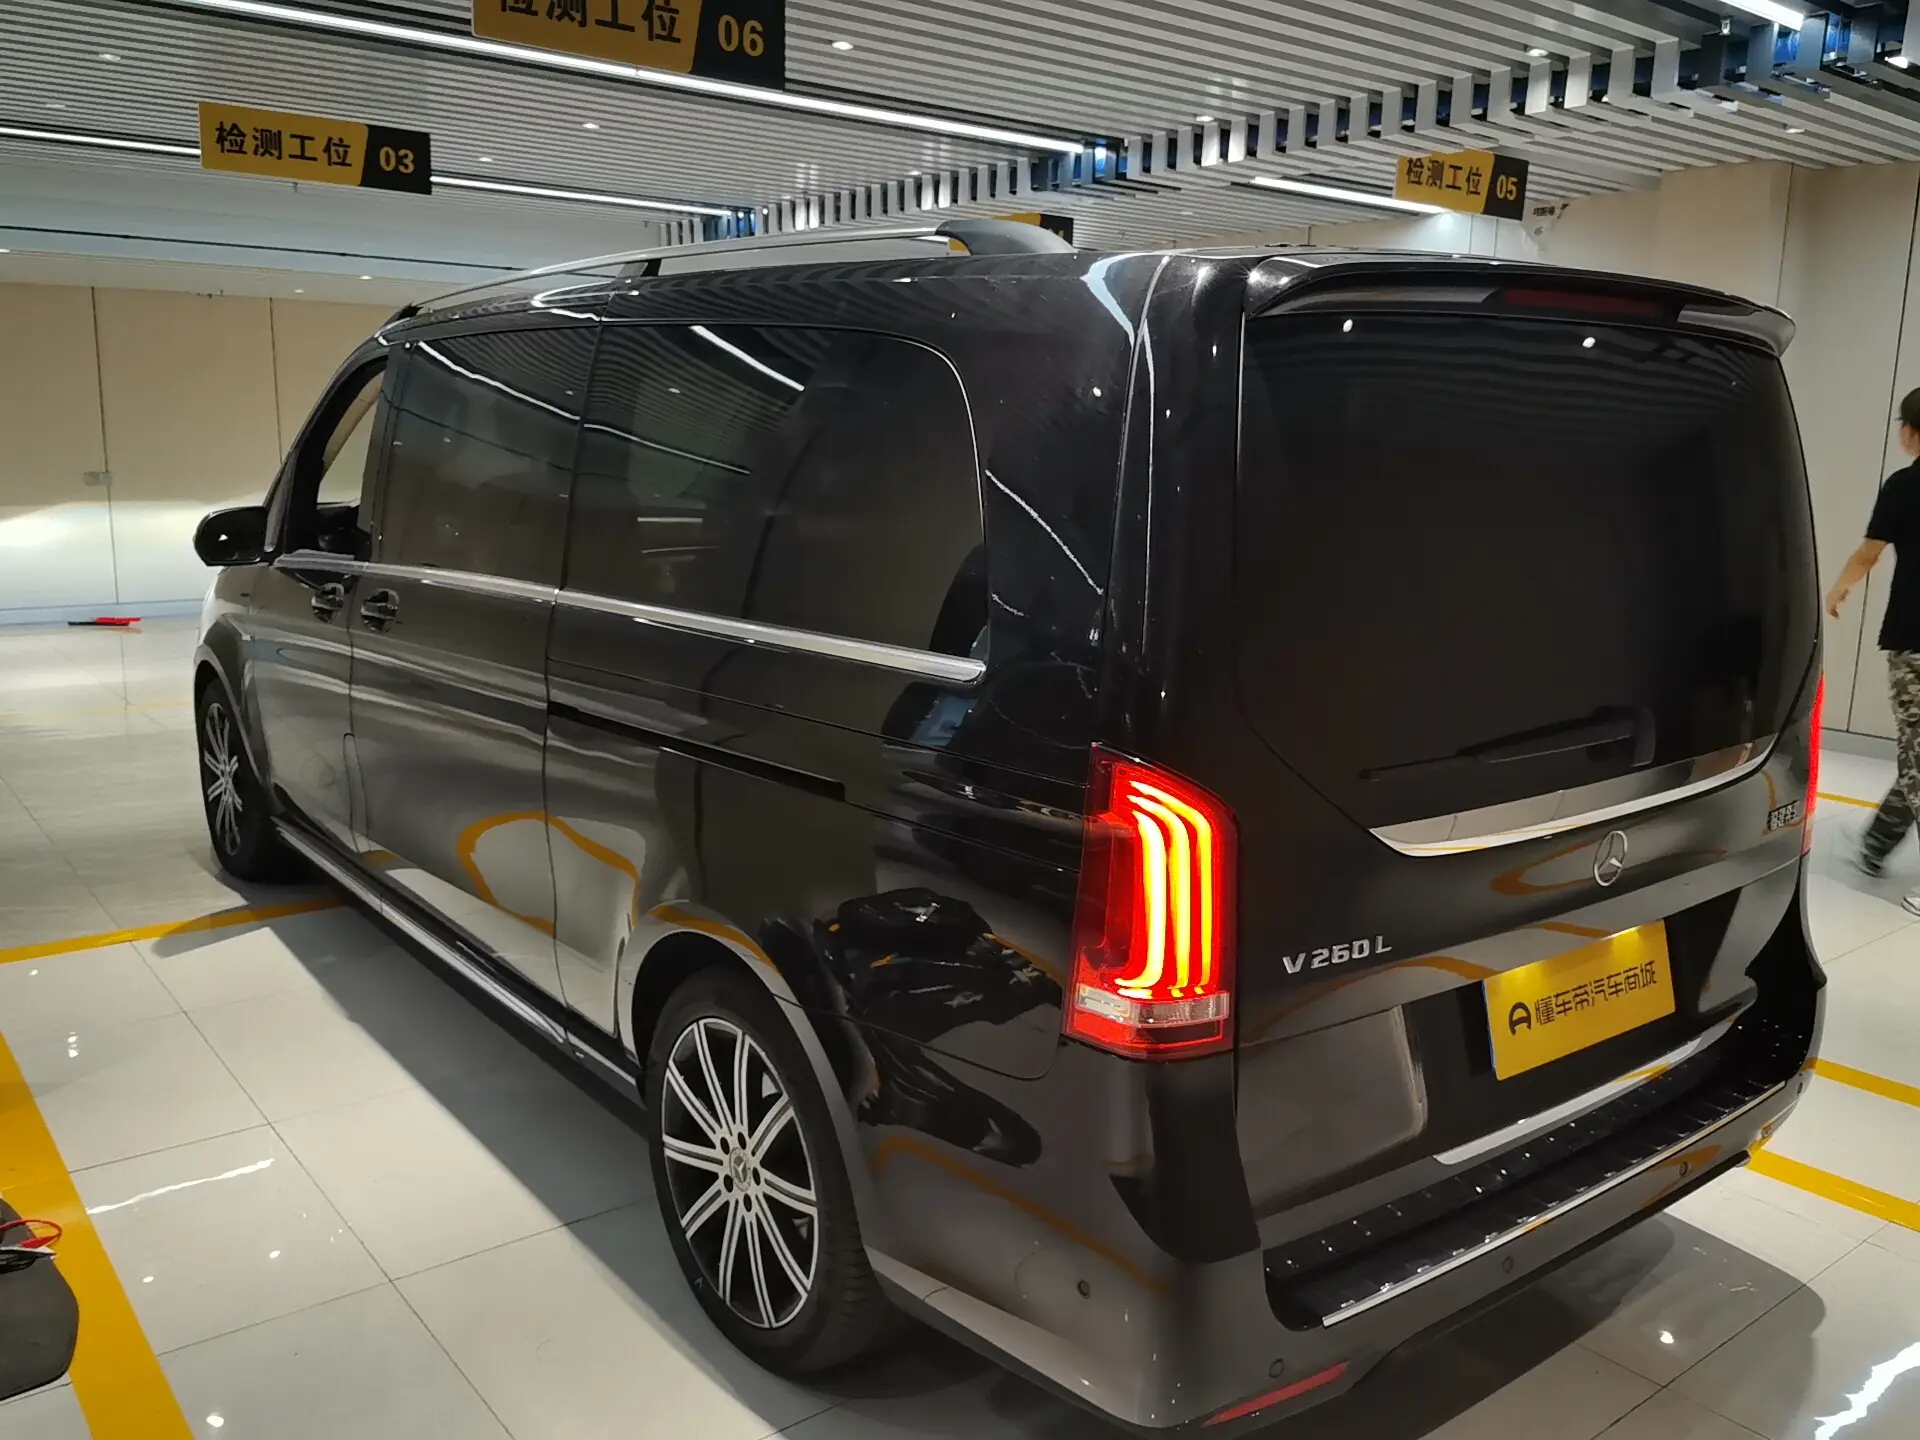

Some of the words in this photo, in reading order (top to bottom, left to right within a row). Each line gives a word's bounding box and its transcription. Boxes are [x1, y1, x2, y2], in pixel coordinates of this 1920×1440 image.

[717, 15, 764, 57] 06
[215, 120, 353, 167] 检测工位
[379, 146, 415, 174] 03
[1406, 157, 1483, 196] 检测工位
[1496, 174, 1518, 201] 05
[1534, 960, 1658, 1026] 懂车帝汽车商城
